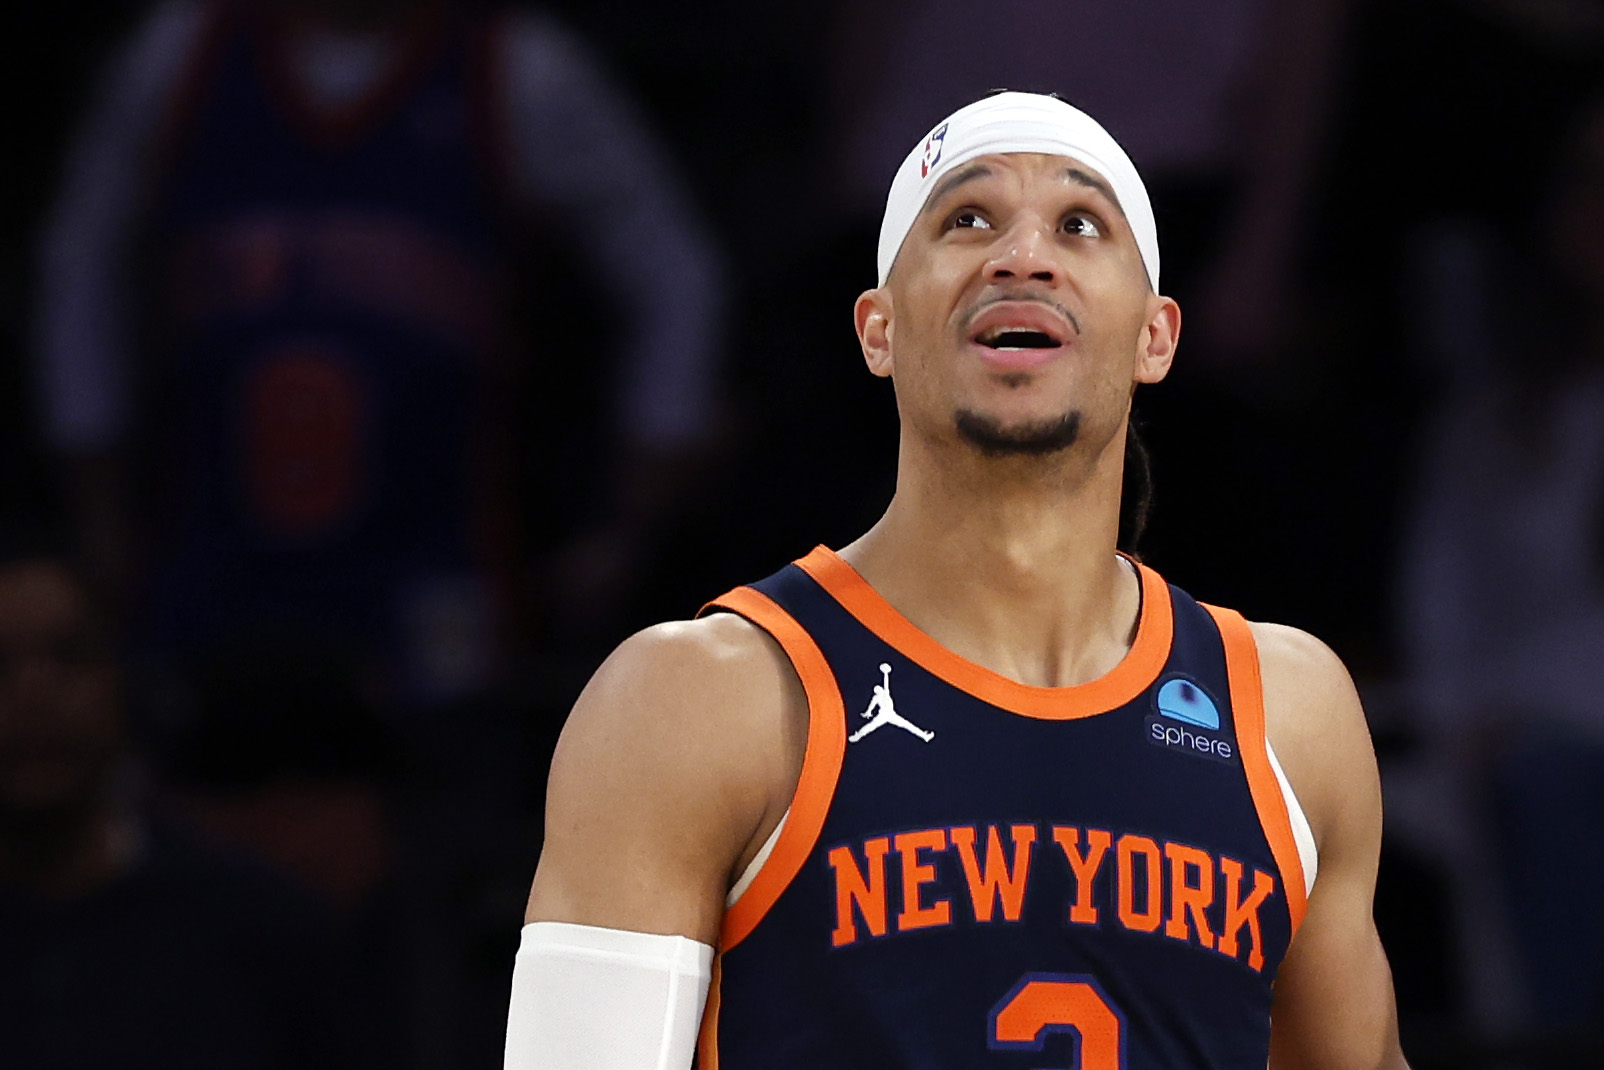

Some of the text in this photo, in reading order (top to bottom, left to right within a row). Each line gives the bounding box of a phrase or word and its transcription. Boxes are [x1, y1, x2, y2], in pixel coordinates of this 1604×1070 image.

[1150, 720, 1232, 759] sphere
[827, 823, 1275, 972] NEW YORK
